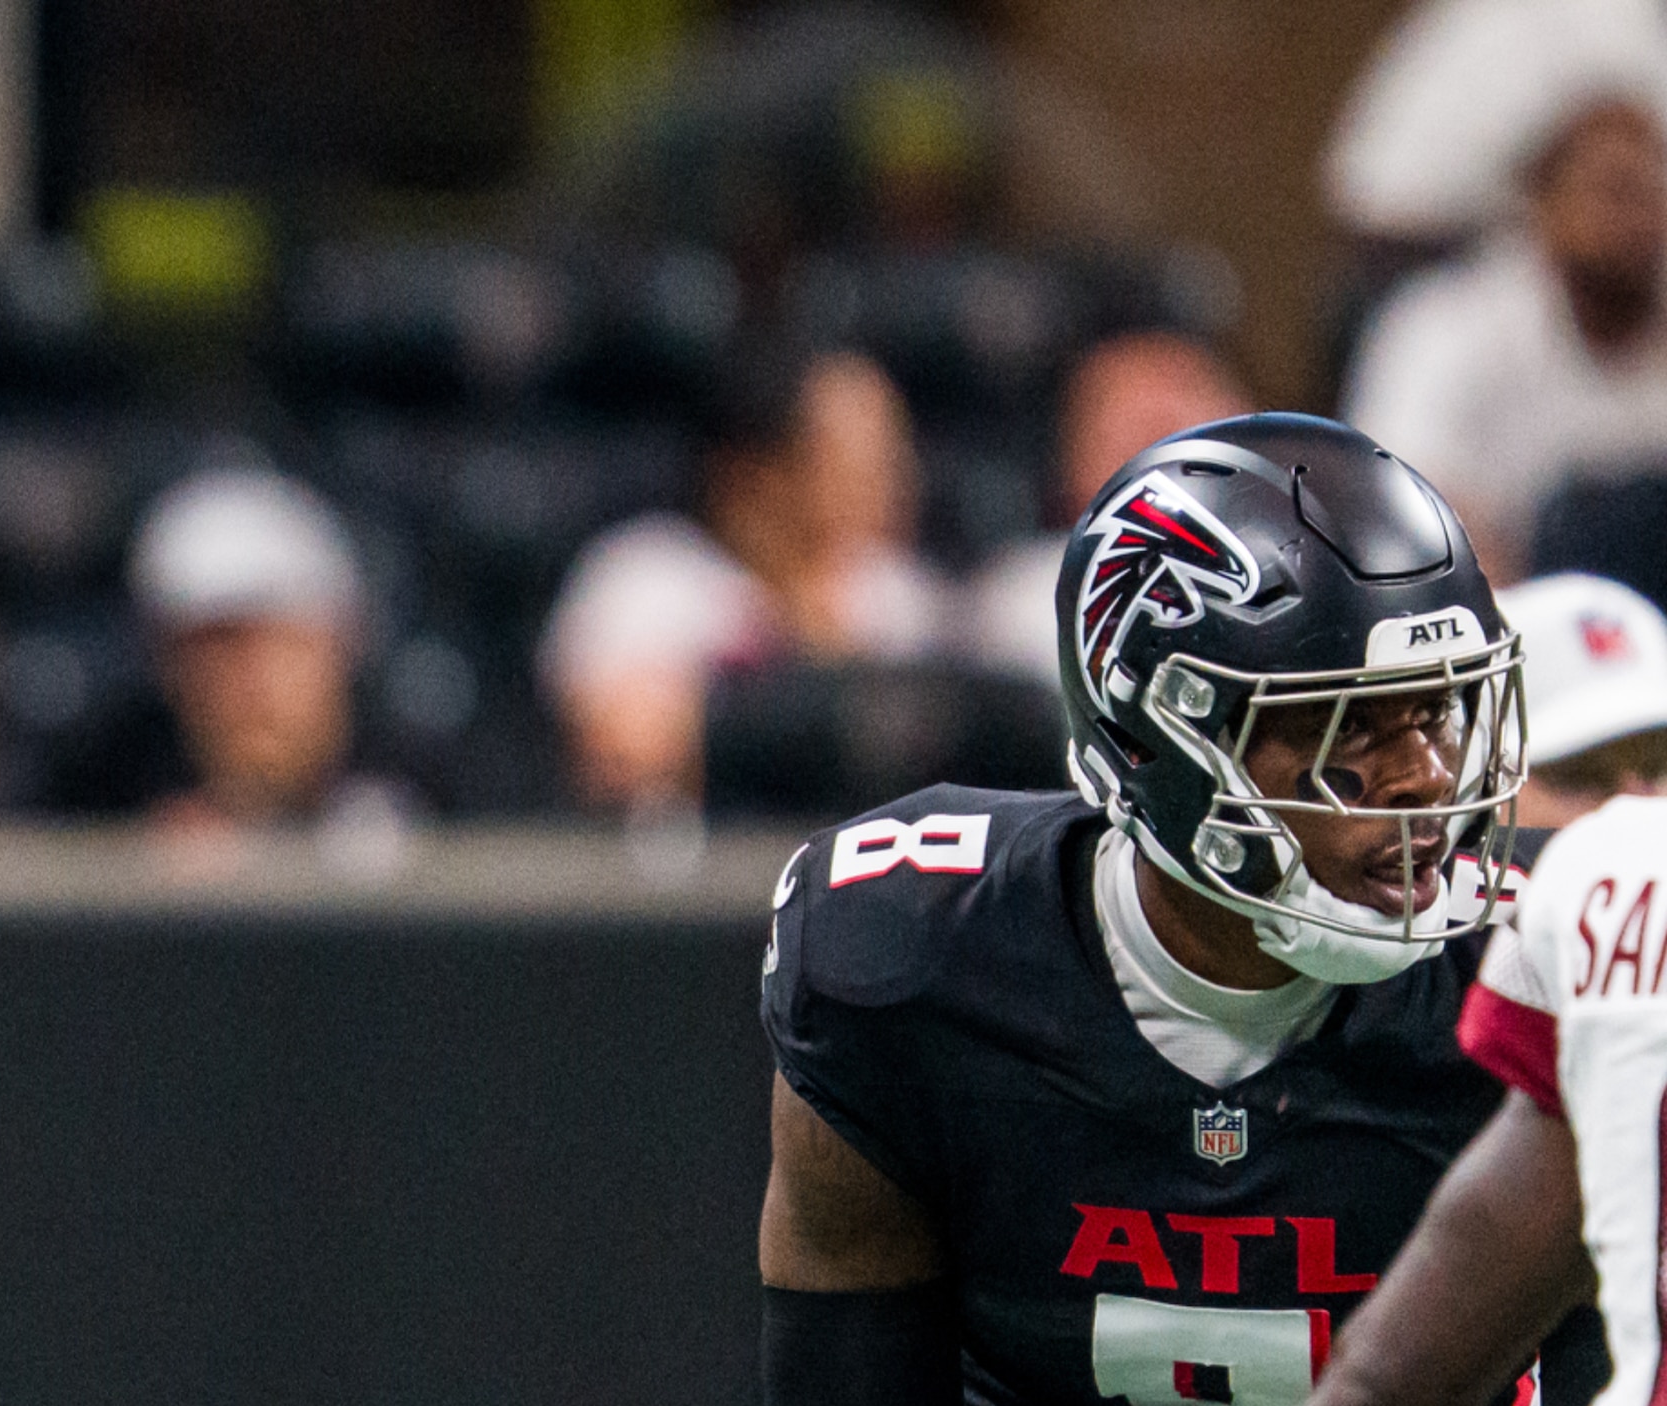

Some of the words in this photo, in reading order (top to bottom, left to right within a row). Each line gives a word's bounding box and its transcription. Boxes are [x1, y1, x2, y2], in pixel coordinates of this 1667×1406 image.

[1407, 617, 1465, 647] ATL
[829, 813, 992, 890] 8
[1203, 1131, 1241, 1155] NFL
[1059, 1202, 1380, 1294] ATL
